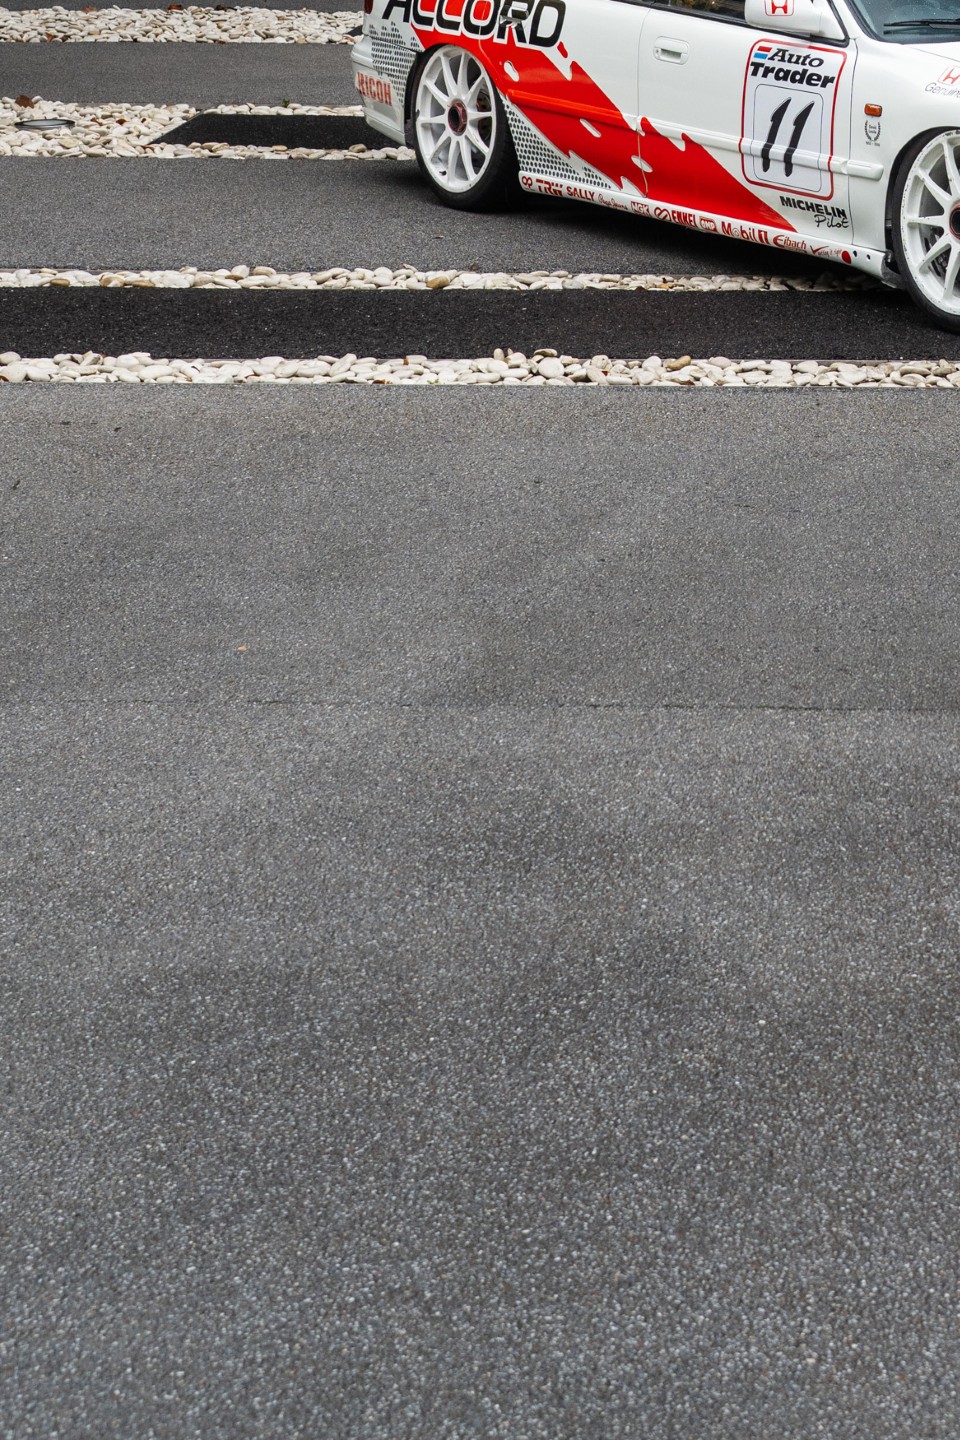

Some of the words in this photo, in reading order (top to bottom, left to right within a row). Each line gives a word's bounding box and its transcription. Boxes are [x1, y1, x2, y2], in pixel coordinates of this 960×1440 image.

[768, 48, 824, 67] Auto
[751, 62, 836, 88] Trader
[357, 71, 392, 106] RICOH
[761, 97, 815, 177] 11
[566, 186, 595, 202] SALLY
[631, 201, 650, 216] NGK
[779, 195, 847, 220] MICHELIN
[814, 214, 849, 229] Pilot
[721, 221, 758, 243] Mobil
[773, 235, 807, 250] Eibach
